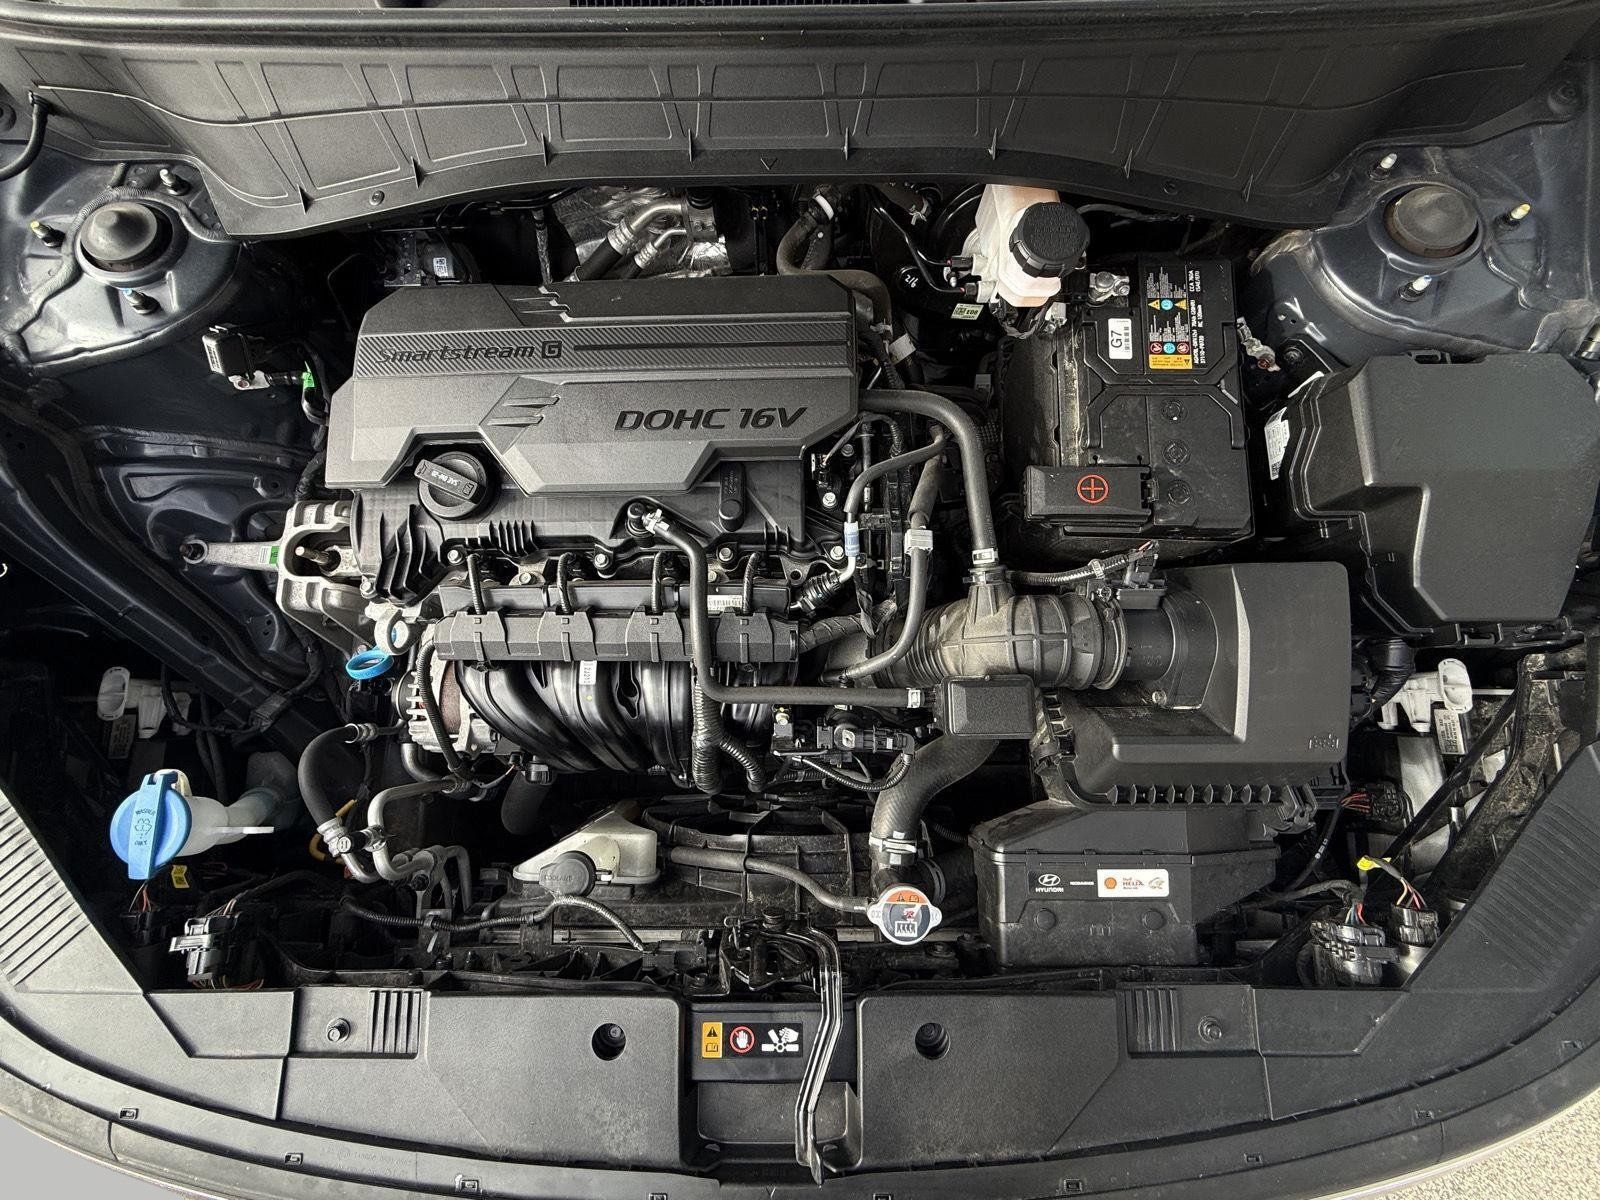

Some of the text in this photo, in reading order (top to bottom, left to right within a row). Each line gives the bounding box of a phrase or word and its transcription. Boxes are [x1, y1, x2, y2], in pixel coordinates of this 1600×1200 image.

[1110, 330, 1123, 348] G7
[375, 342, 562, 363] Smartstream G
[614, 406, 808, 430] DOHC 16V
